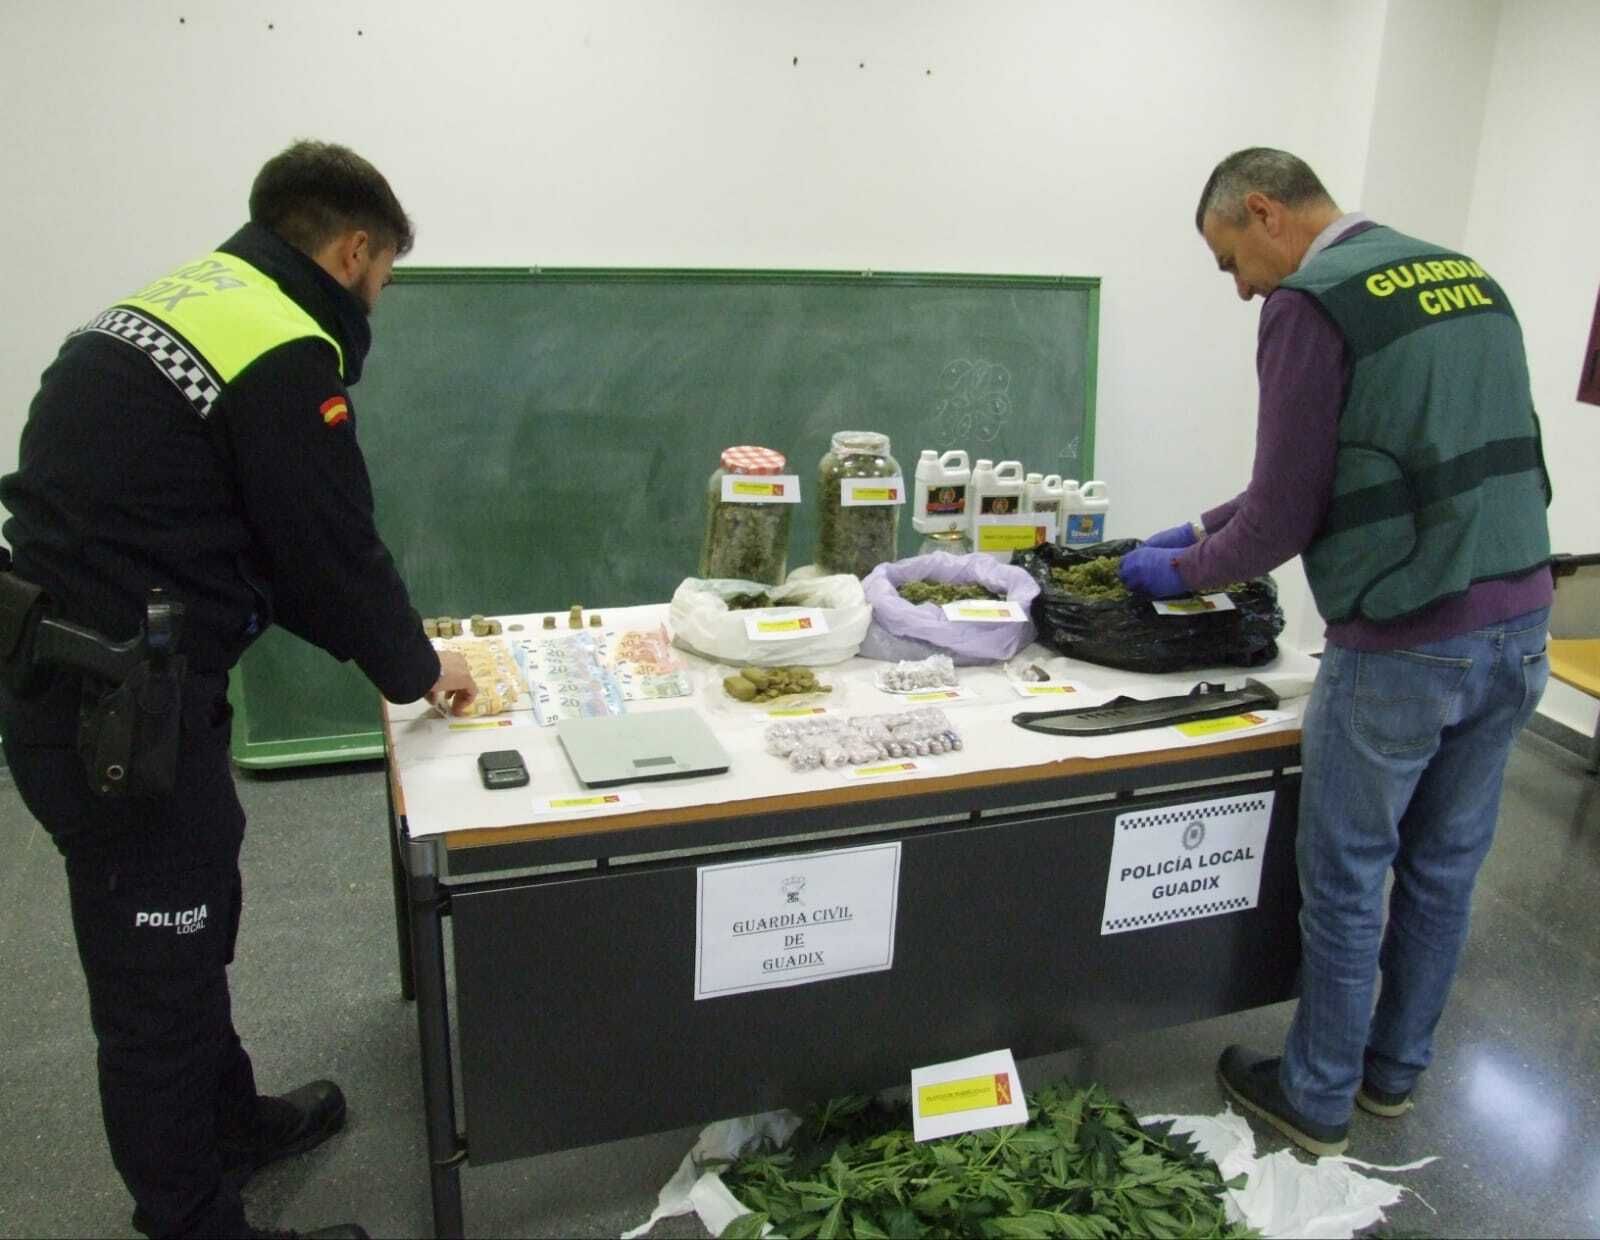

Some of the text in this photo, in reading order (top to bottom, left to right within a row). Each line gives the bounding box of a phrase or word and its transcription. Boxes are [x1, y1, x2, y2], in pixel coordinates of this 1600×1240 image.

[1366, 259, 1488, 297] GUARDIA
[1418, 284, 1493, 315] CIVIL
[560, 697, 580, 707] 20
[1120, 847, 1255, 882] POLICÍA LOCAL
[1152, 875, 1222, 900] GUADIX
[135, 903, 208, 927] POLICIA
[732, 905, 853, 934] GUARDIA CIVIL
[176, 920, 207, 935] LOCAL
[784, 933, 804, 947] DE
[762, 950, 825, 971] GUADIX
